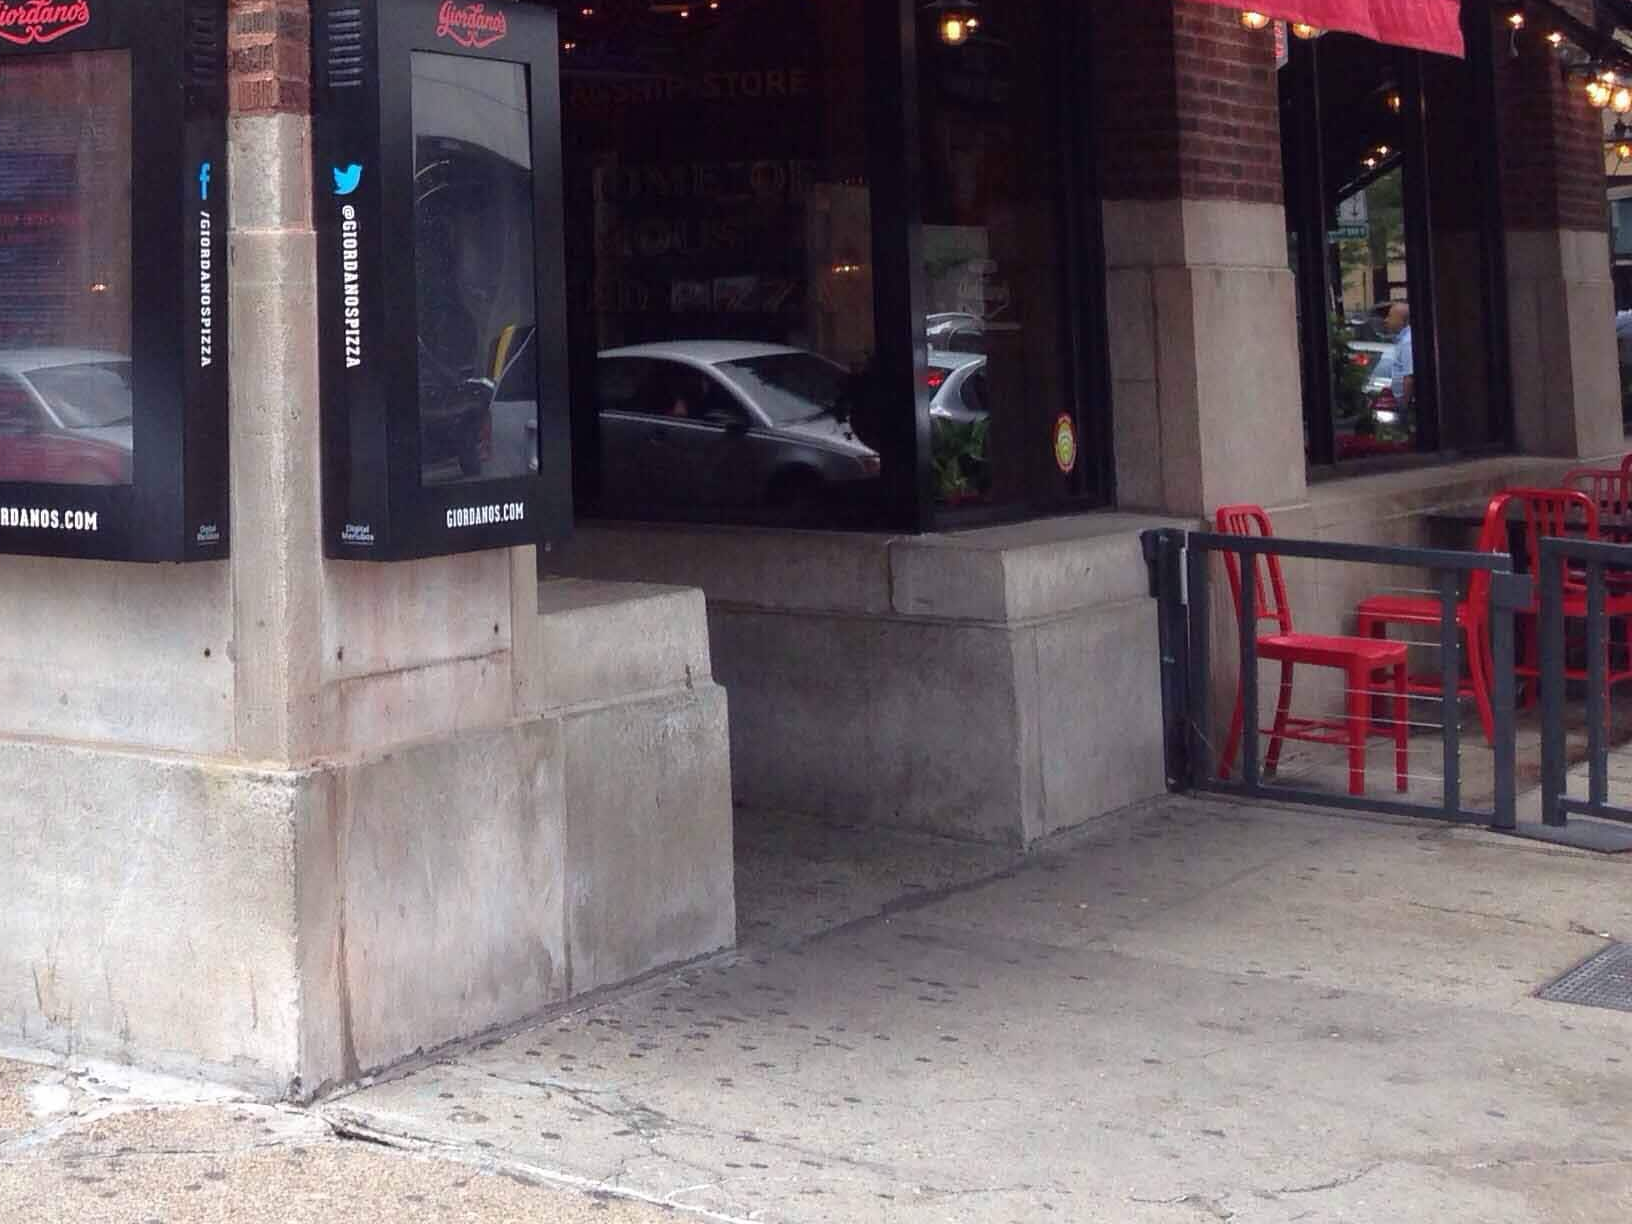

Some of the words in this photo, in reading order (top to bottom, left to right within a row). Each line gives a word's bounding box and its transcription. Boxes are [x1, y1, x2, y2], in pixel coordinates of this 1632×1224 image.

[436, 0, 506, 48] Giordano's
[701, 67, 810, 98] STORE
[199, 210, 212, 367] /GIORDANOSPIZZA
[341, 204, 361, 369] @GIORDANOSPIZZA
[446, 502, 524, 528] GIORDANOS.COM
